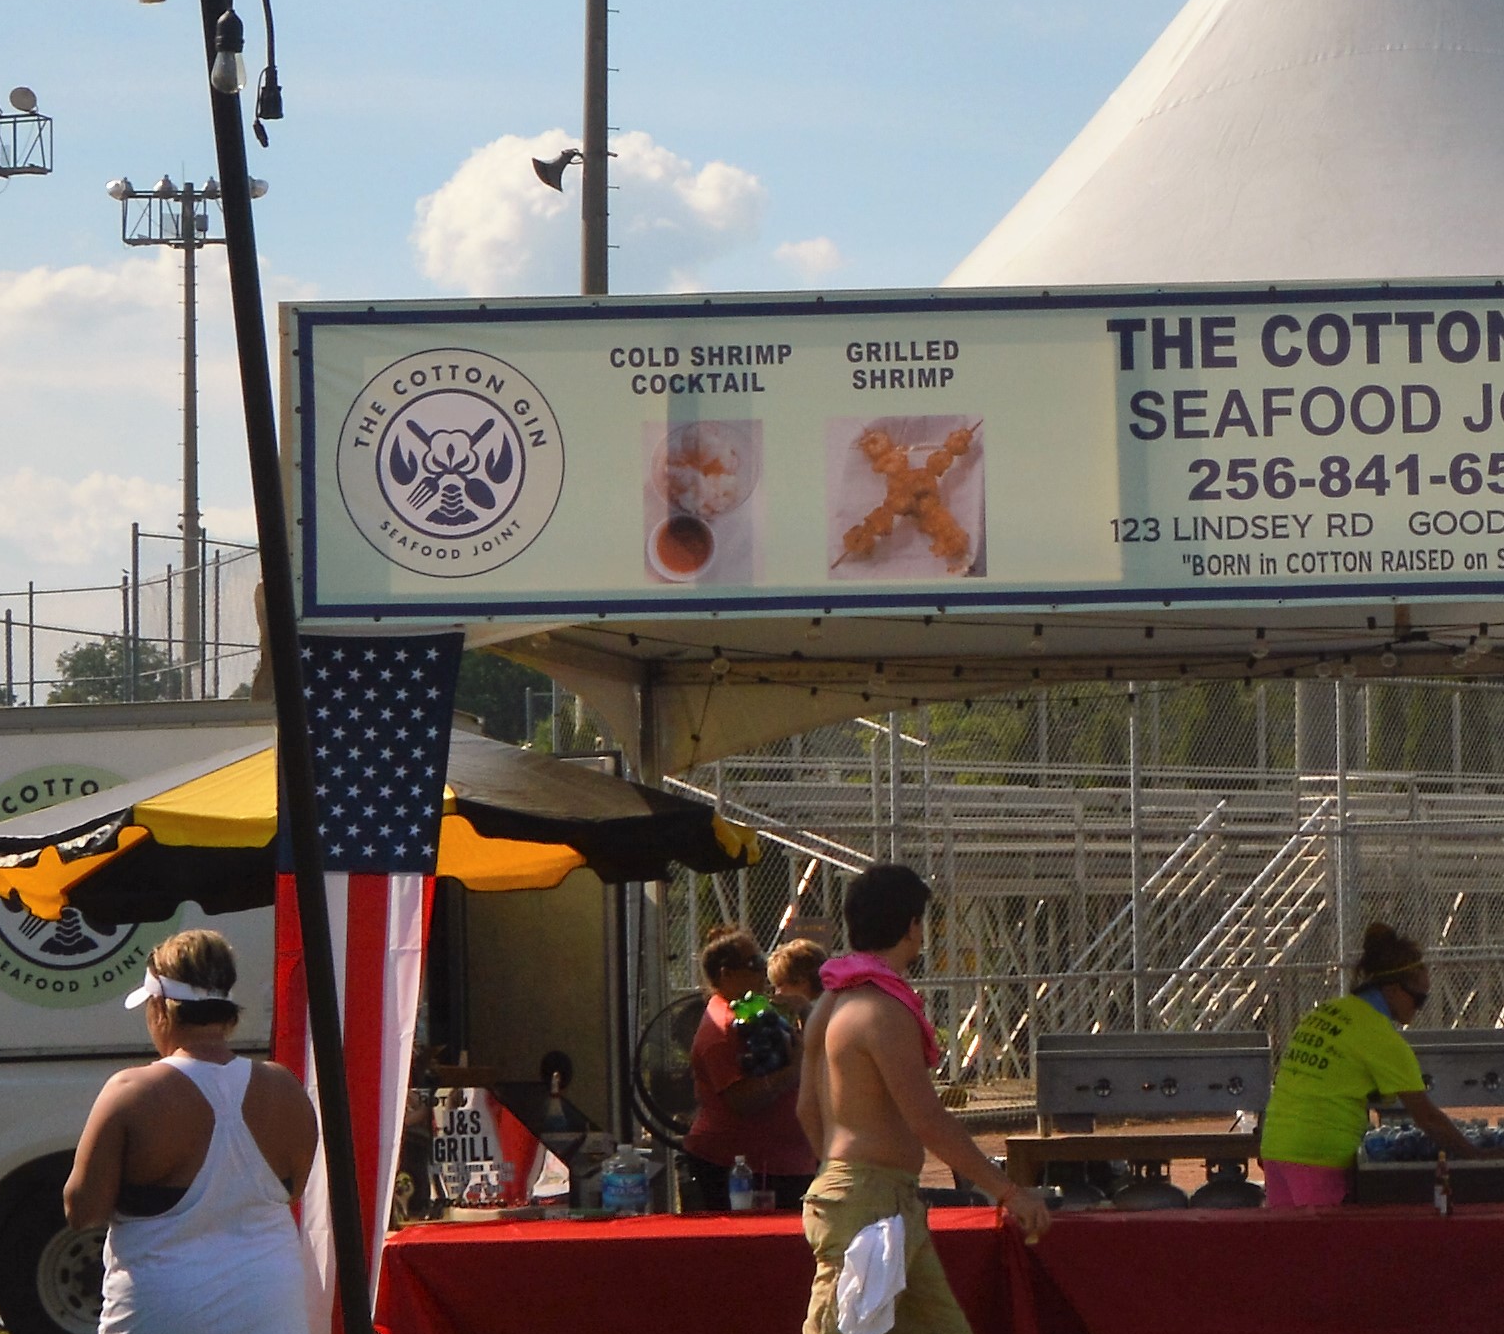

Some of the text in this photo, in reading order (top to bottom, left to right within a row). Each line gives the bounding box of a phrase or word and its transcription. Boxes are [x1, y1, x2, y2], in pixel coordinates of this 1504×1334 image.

[609, 344, 792, 369] COLD SHRIMP
[846, 340, 960, 364] GRILLED
[1107, 317, 1238, 371] THE
[631, 371, 766, 396] COCKTAIL
[852, 366, 954, 390] SHRIMP
[354, 364, 547, 448] THE COTTON GIN
[1129, 385, 1441, 441] SEAFOOD
[379, 519, 521, 560] SEAFOOD JOINT
[1109, 516, 1161, 543] 123
[1173, 513, 1314, 542] LINDSEY
[1326, 512, 1374, 539] RD
[1182, 553, 1251, 577] "BORN
[1259, 552, 1278, 575] in
[1286, 550, 1373, 574] COTTON
[1380, 548, 1455, 573] RAISED
[1463, 552, 1489, 571] on
[1, 778, 100, 814] COTTO
[92, 946, 146, 988] JOINT
[443, 1110, 482, 1136] J&S
[435, 1137, 494, 1163] GRILL
